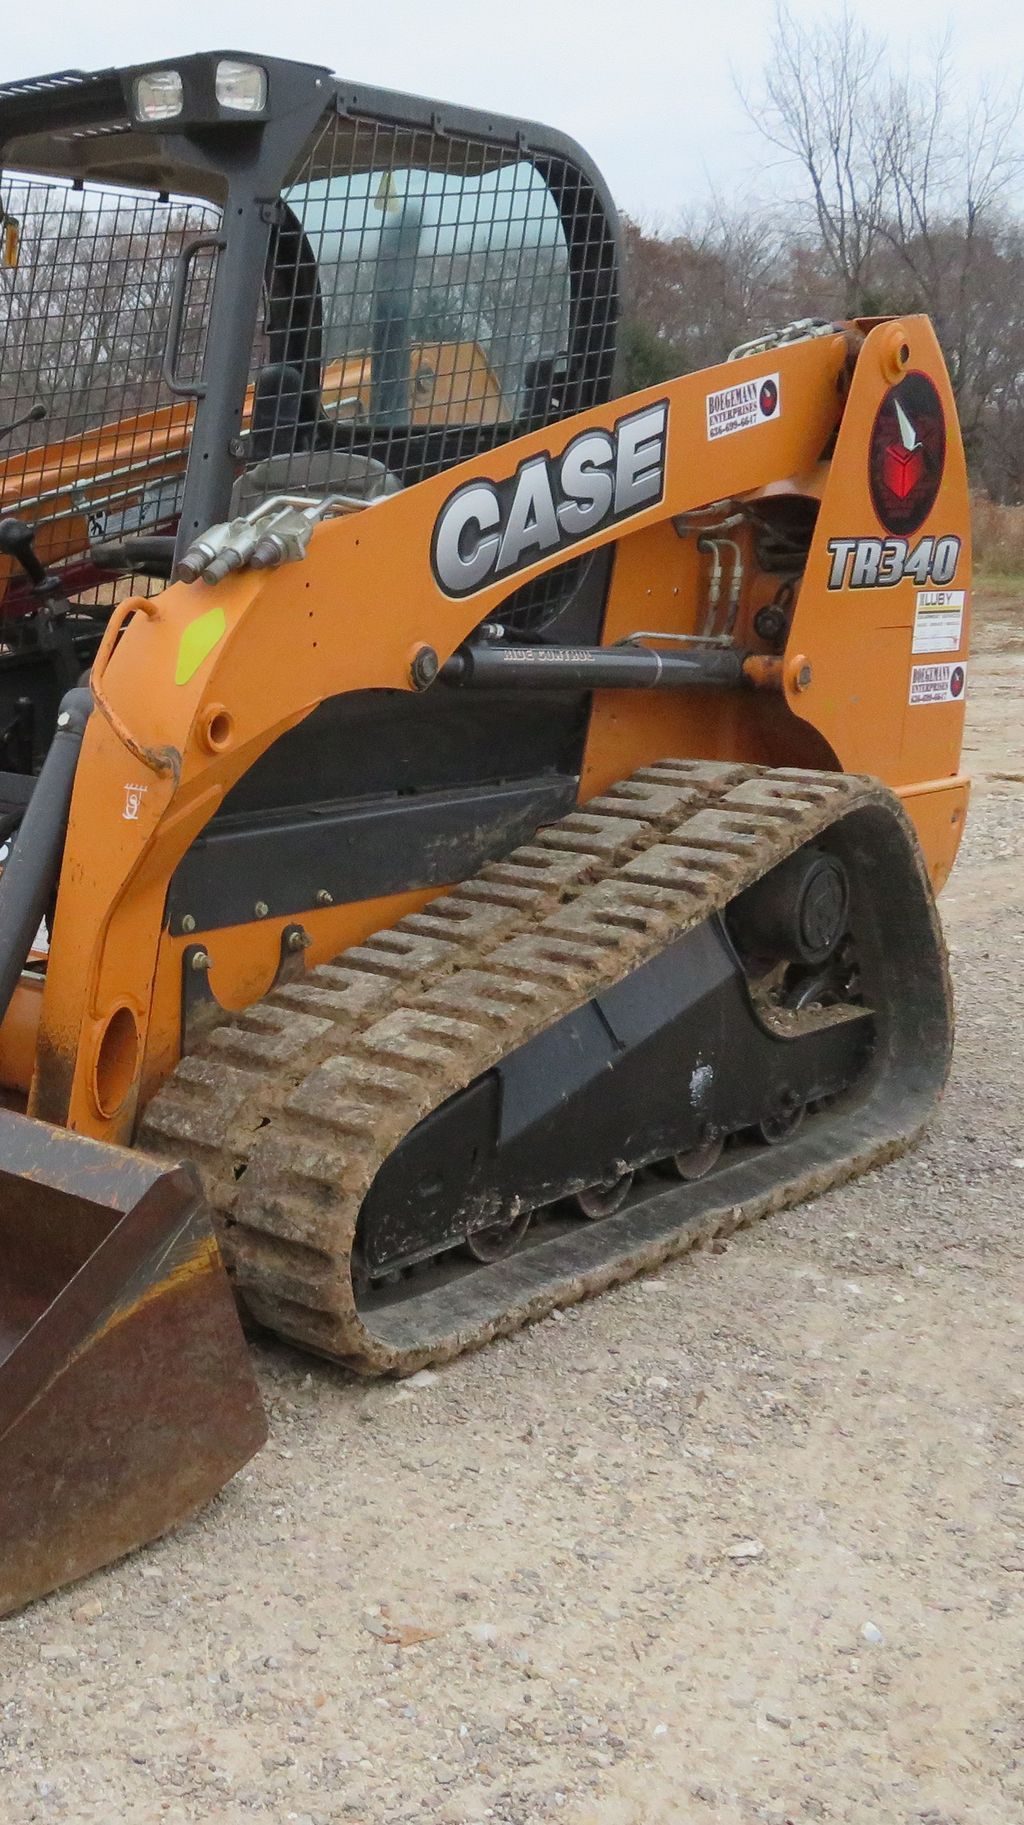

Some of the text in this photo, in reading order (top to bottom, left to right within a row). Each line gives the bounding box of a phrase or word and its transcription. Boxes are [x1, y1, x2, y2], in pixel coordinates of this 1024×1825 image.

[708, 382, 757, 415] BOEGEMANN
[709, 401, 758, 427] ENTERPRISES
[432, 400, 668, 596] CASE
[827, 535, 961, 590] TR340
